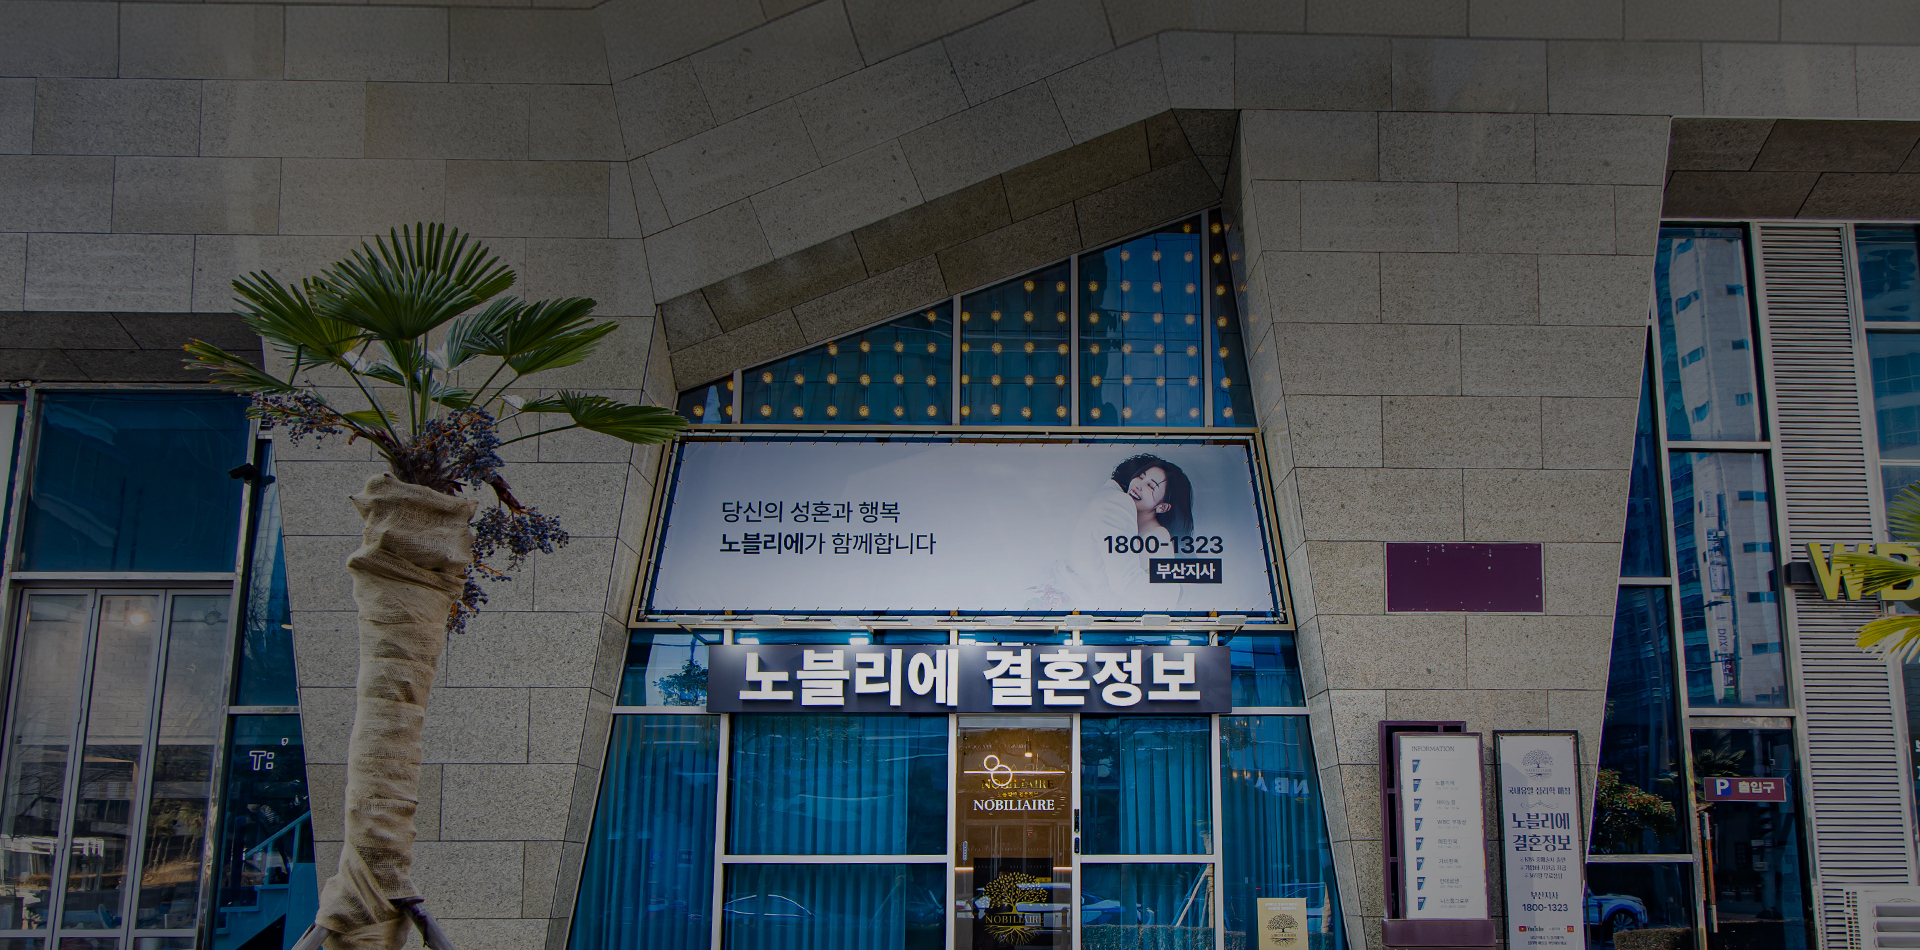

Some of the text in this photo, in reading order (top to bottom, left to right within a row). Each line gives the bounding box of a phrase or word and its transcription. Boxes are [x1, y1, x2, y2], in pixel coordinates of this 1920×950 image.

[722, 501, 901, 523] 당신의 성혼과 행복
[720, 532, 937, 554] 노블리에가 함께합니다
[1104, 535, 1224, 554] 1800-1323
[1156, 562, 1216, 580] 부산지사
[738, 649, 1201, 708] 노블리에 결혼정보
[1508, 786, 1534, 795] 국내유일
[1738, 781, 1775, 794] 출입구
[973, 799, 1055, 811] NOBILIAIRE
[1512, 812, 1570, 830] 노블리에
[1512, 834, 1572, 852] 결혼정보
[1530, 891, 1559, 900] 부산지사
[1522, 903, 1569, 912] 1800-1323
[985, 915, 1044, 924] NOBILIAIRE
